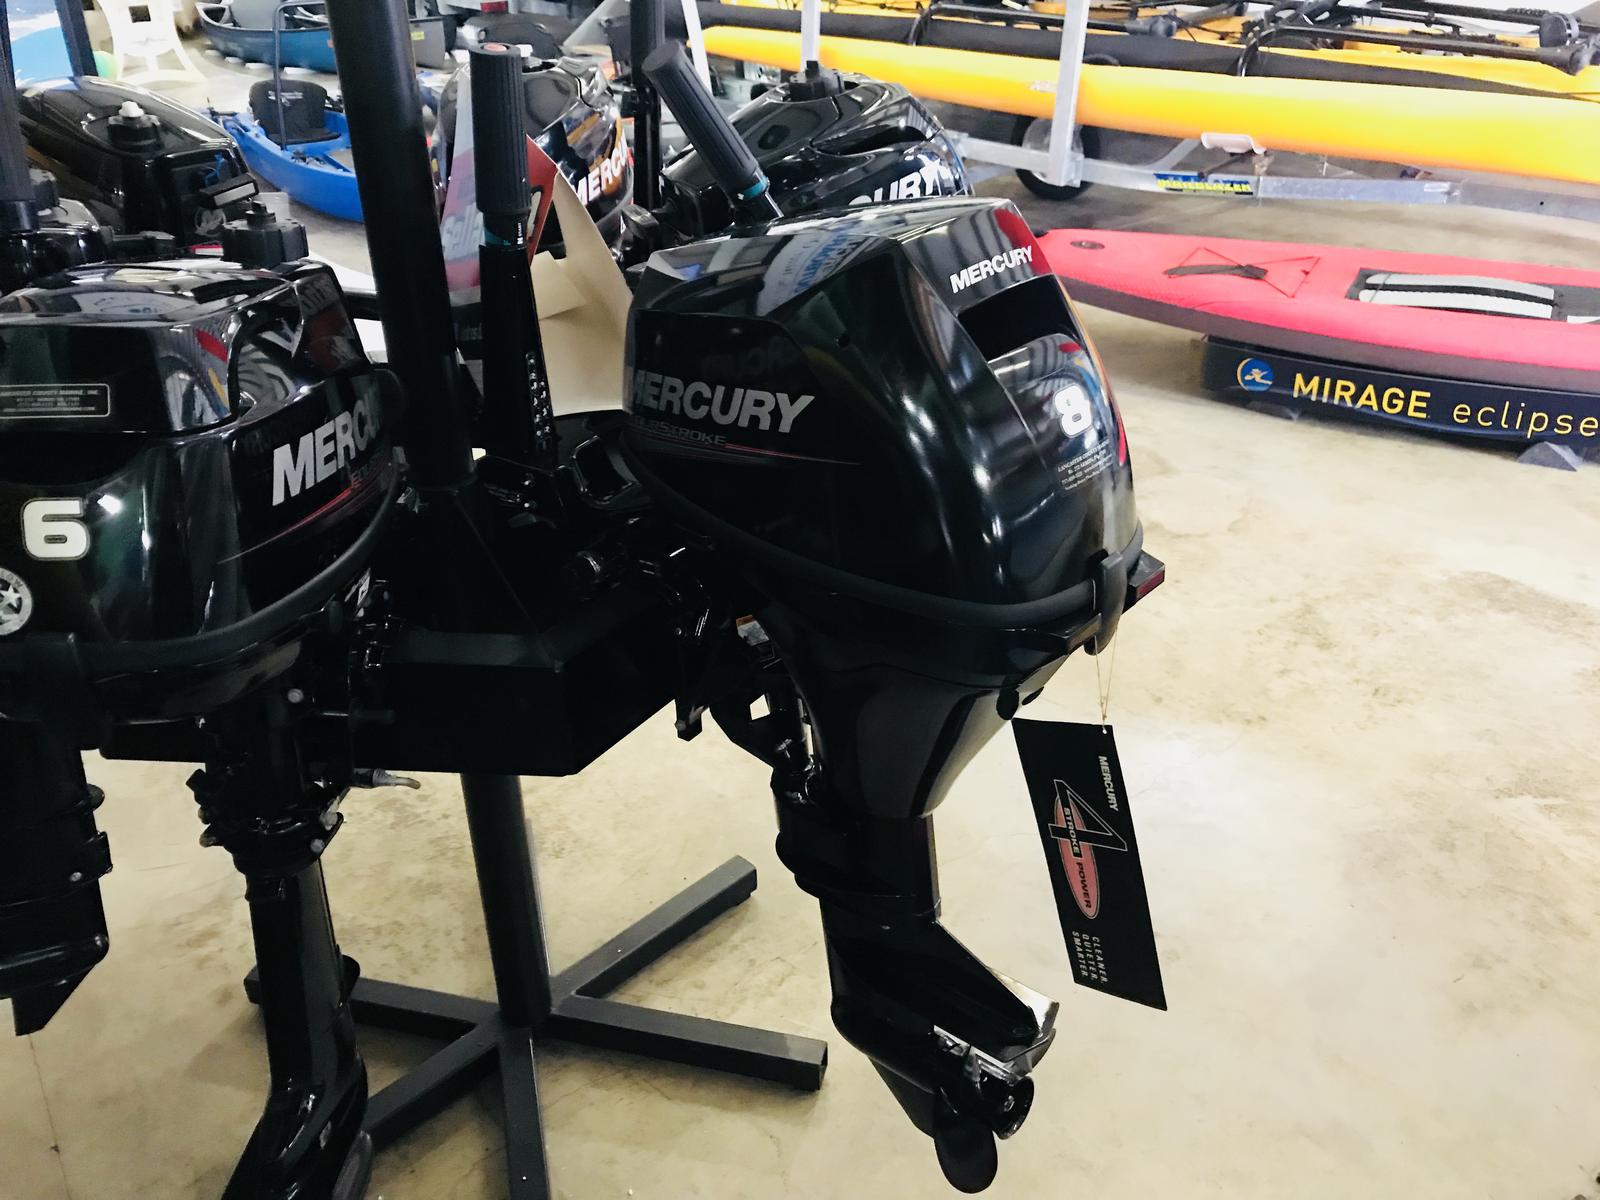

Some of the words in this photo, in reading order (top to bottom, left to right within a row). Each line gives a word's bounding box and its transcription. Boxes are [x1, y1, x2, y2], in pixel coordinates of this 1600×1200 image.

[572, 130, 628, 206] MERCU
[949, 245, 1033, 294] MERCURY
[1053, 384, 1092, 438] 8
[1292, 372, 1432, 420] MIRAGE
[1452, 401, 1600, 439] eclipse
[271, 392, 378, 507] MERCU
[21, 498, 90, 560] 6
[1048, 779, 1128, 851] 4
[1098, 755, 1119, 812] MERCURY
[1063, 807, 1081, 856] STROKE
[1075, 861, 1093, 909] POWER
